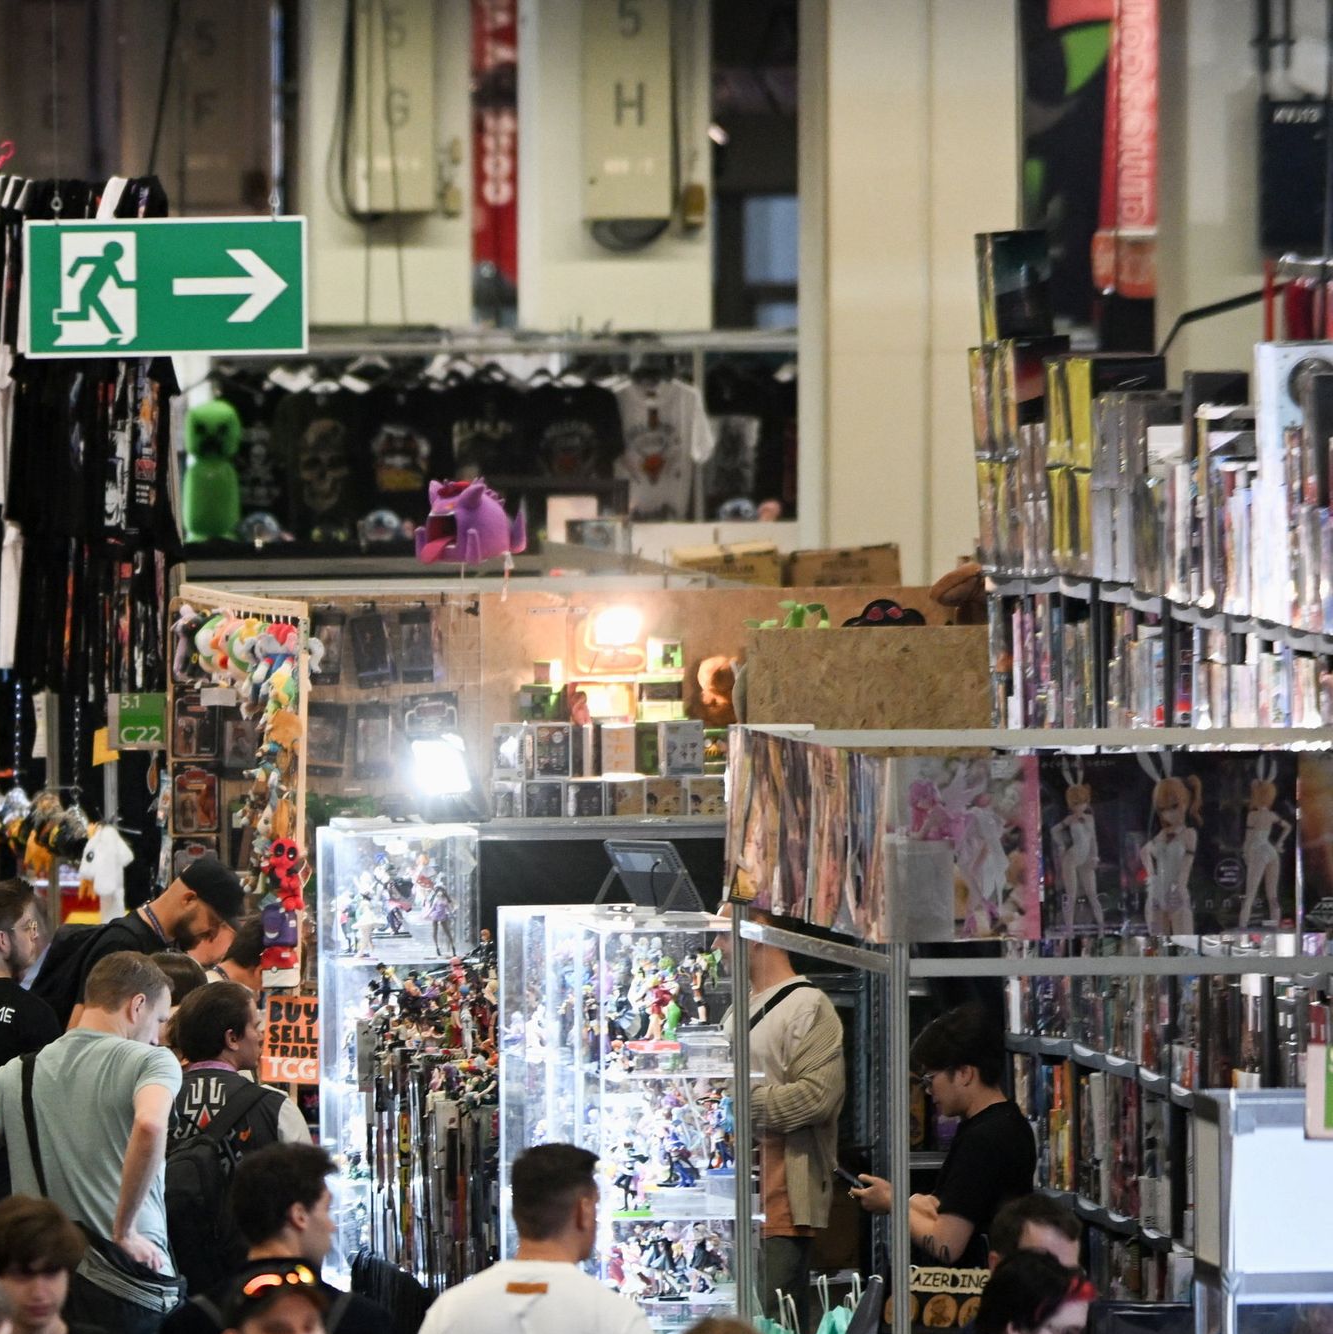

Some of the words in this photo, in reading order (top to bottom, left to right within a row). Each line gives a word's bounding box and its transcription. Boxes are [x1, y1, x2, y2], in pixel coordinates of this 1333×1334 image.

[614, 80, 645, 126] H
[121, 695, 141, 708] 5.1
[119, 726, 162, 745] C22
[268, 1024, 318, 1045] SELL
[268, 1044, 318, 1059] TRADE
[268, 1057, 317, 1079] TCG
[910, 1272, 990, 1289] AZERDING
